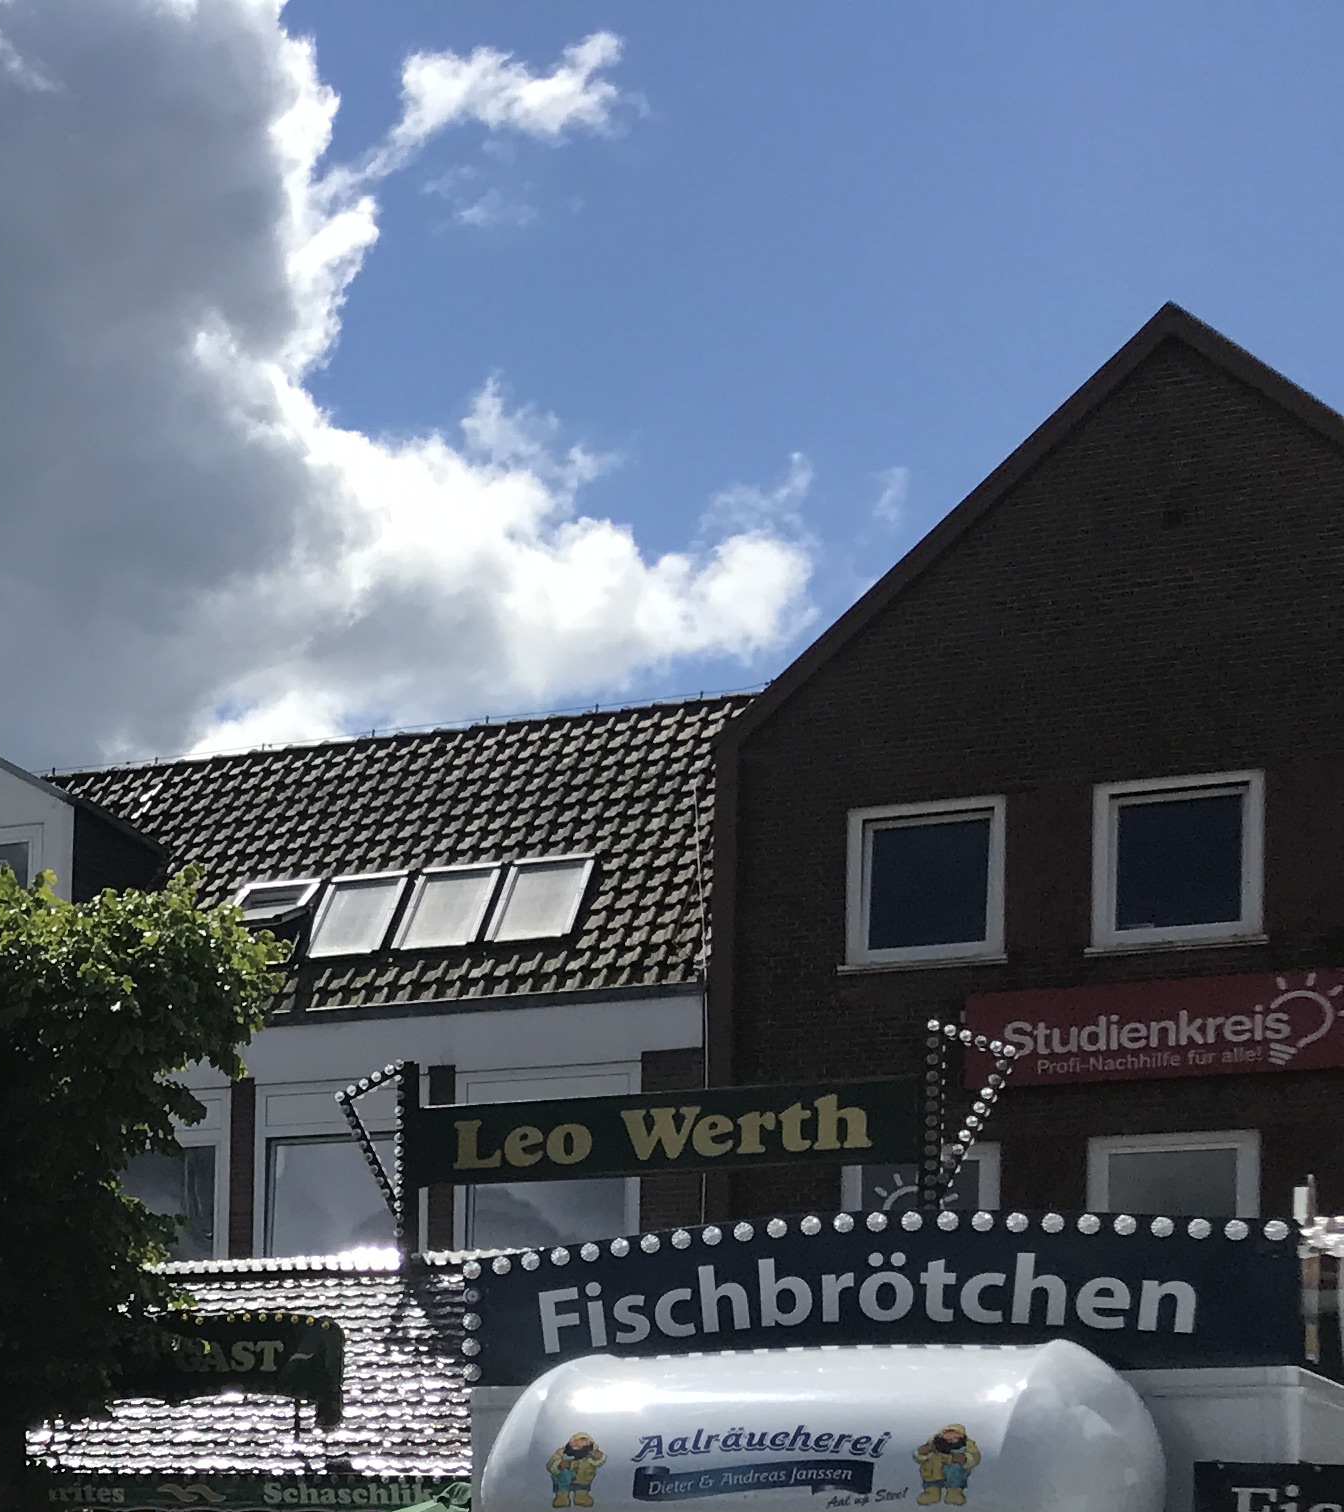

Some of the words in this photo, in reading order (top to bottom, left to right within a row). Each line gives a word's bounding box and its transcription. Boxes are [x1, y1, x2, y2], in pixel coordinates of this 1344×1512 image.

[1004, 1004, 1292, 1057] Studienkreis
[1037, 1053, 1181, 1075] Profi-Nachhilfe
[1187, 1049, 1215, 1065] für
[1222, 1047, 1263, 1064] alle!
[453, 1119, 593, 1169] Leo
[620, 1093, 874, 1161] Werth
[537, 1251, 1198, 1354] Fischbrötchen
[631, 1424, 892, 1461] Aalräucherei
[263, 1482, 438, 1506] Schaschlik
[648, 1479, 695, 1496] Dieter
[699, 1474, 715, 1489] &
[721, 1467, 787, 1486] Andreas
[789, 1466, 853, 1484] Janssen
